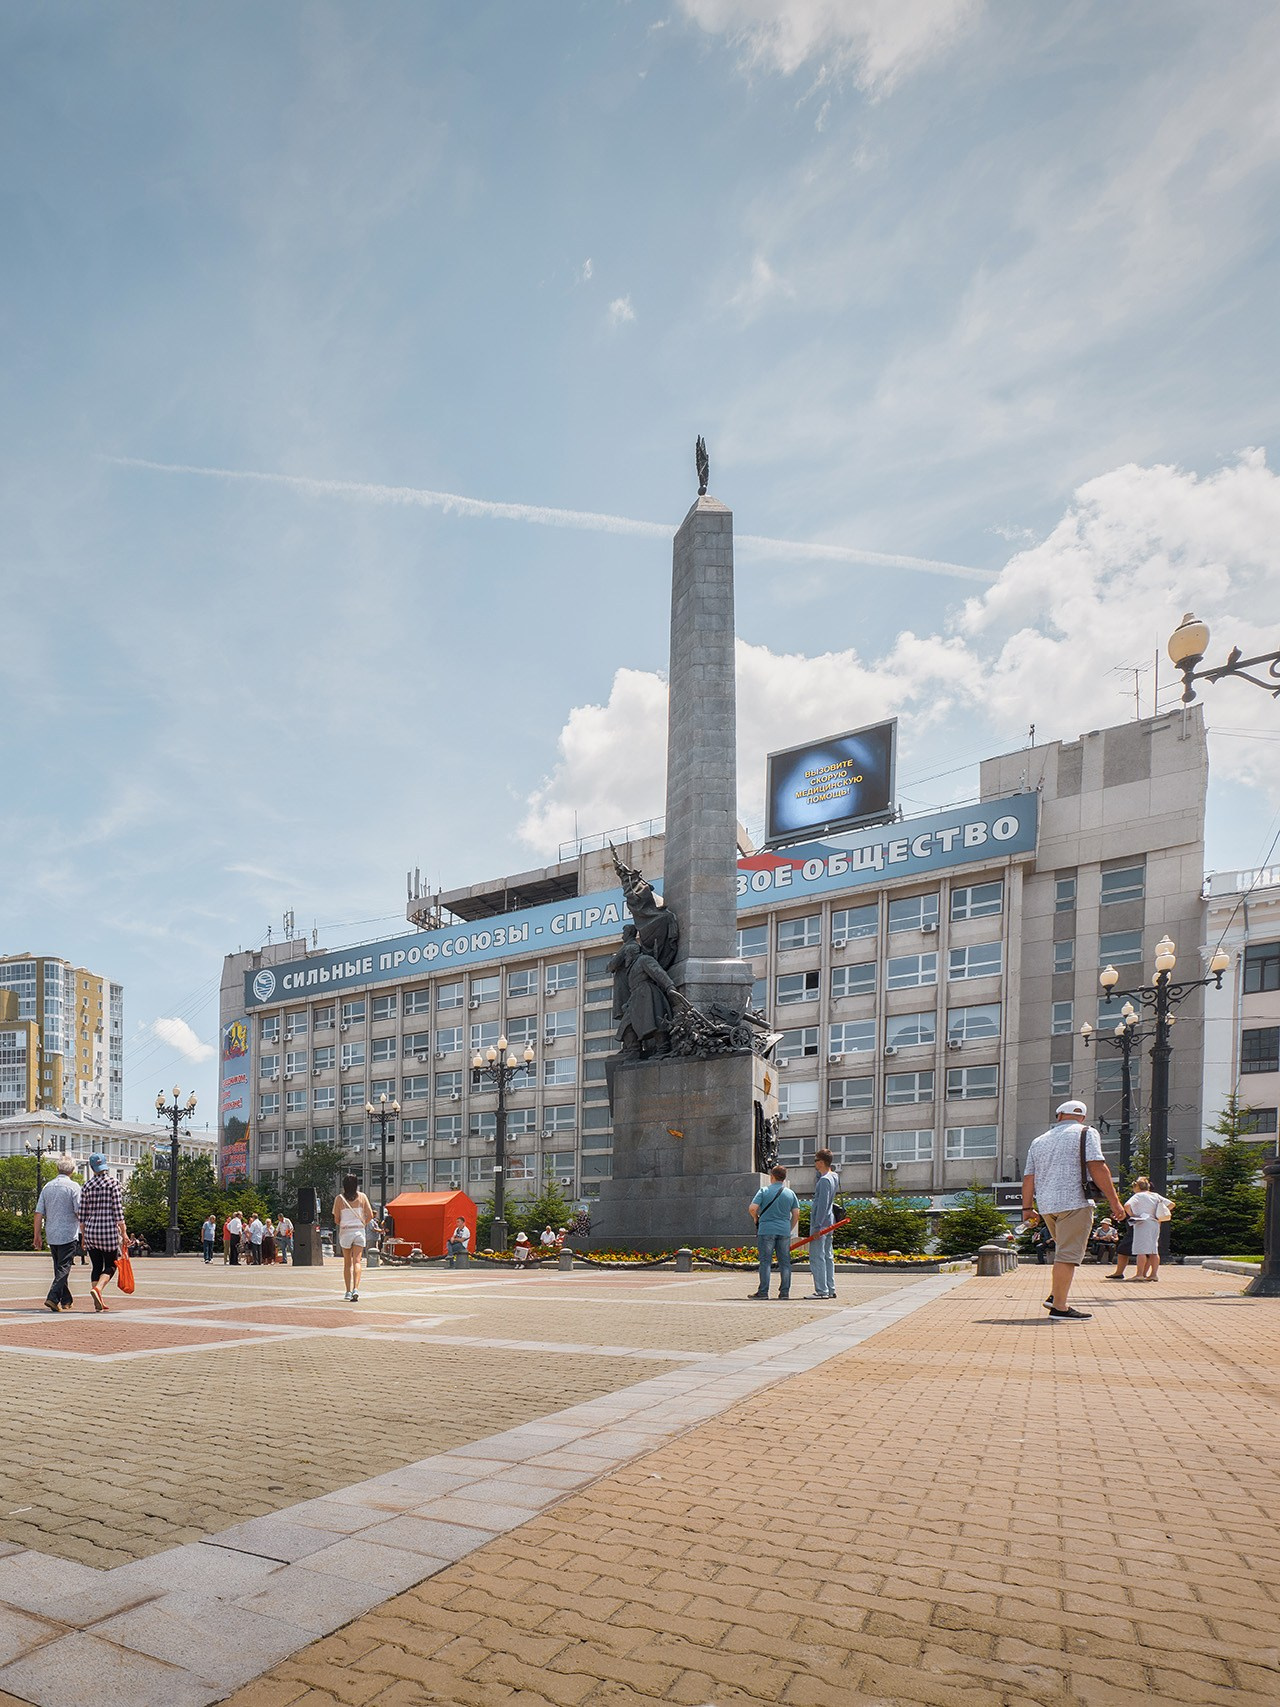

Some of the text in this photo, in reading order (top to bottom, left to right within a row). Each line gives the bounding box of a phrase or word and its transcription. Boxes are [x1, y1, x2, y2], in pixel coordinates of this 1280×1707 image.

[804, 759, 853, 778] ВЫЗОВИТЕ
[810, 770, 847, 786] СКОРУЮ
[795, 775, 863, 799] МЕДИЦИНСКУЮ
[806, 787, 850, 805] ПОМОЩЬ!
[282, 956, 373, 990] СИЛЬНЫЕ
[379, 922, 529, 970] ПРОФСОЮЗЫ
[801, 814, 1020, 881] ОБЩЕСТВО
